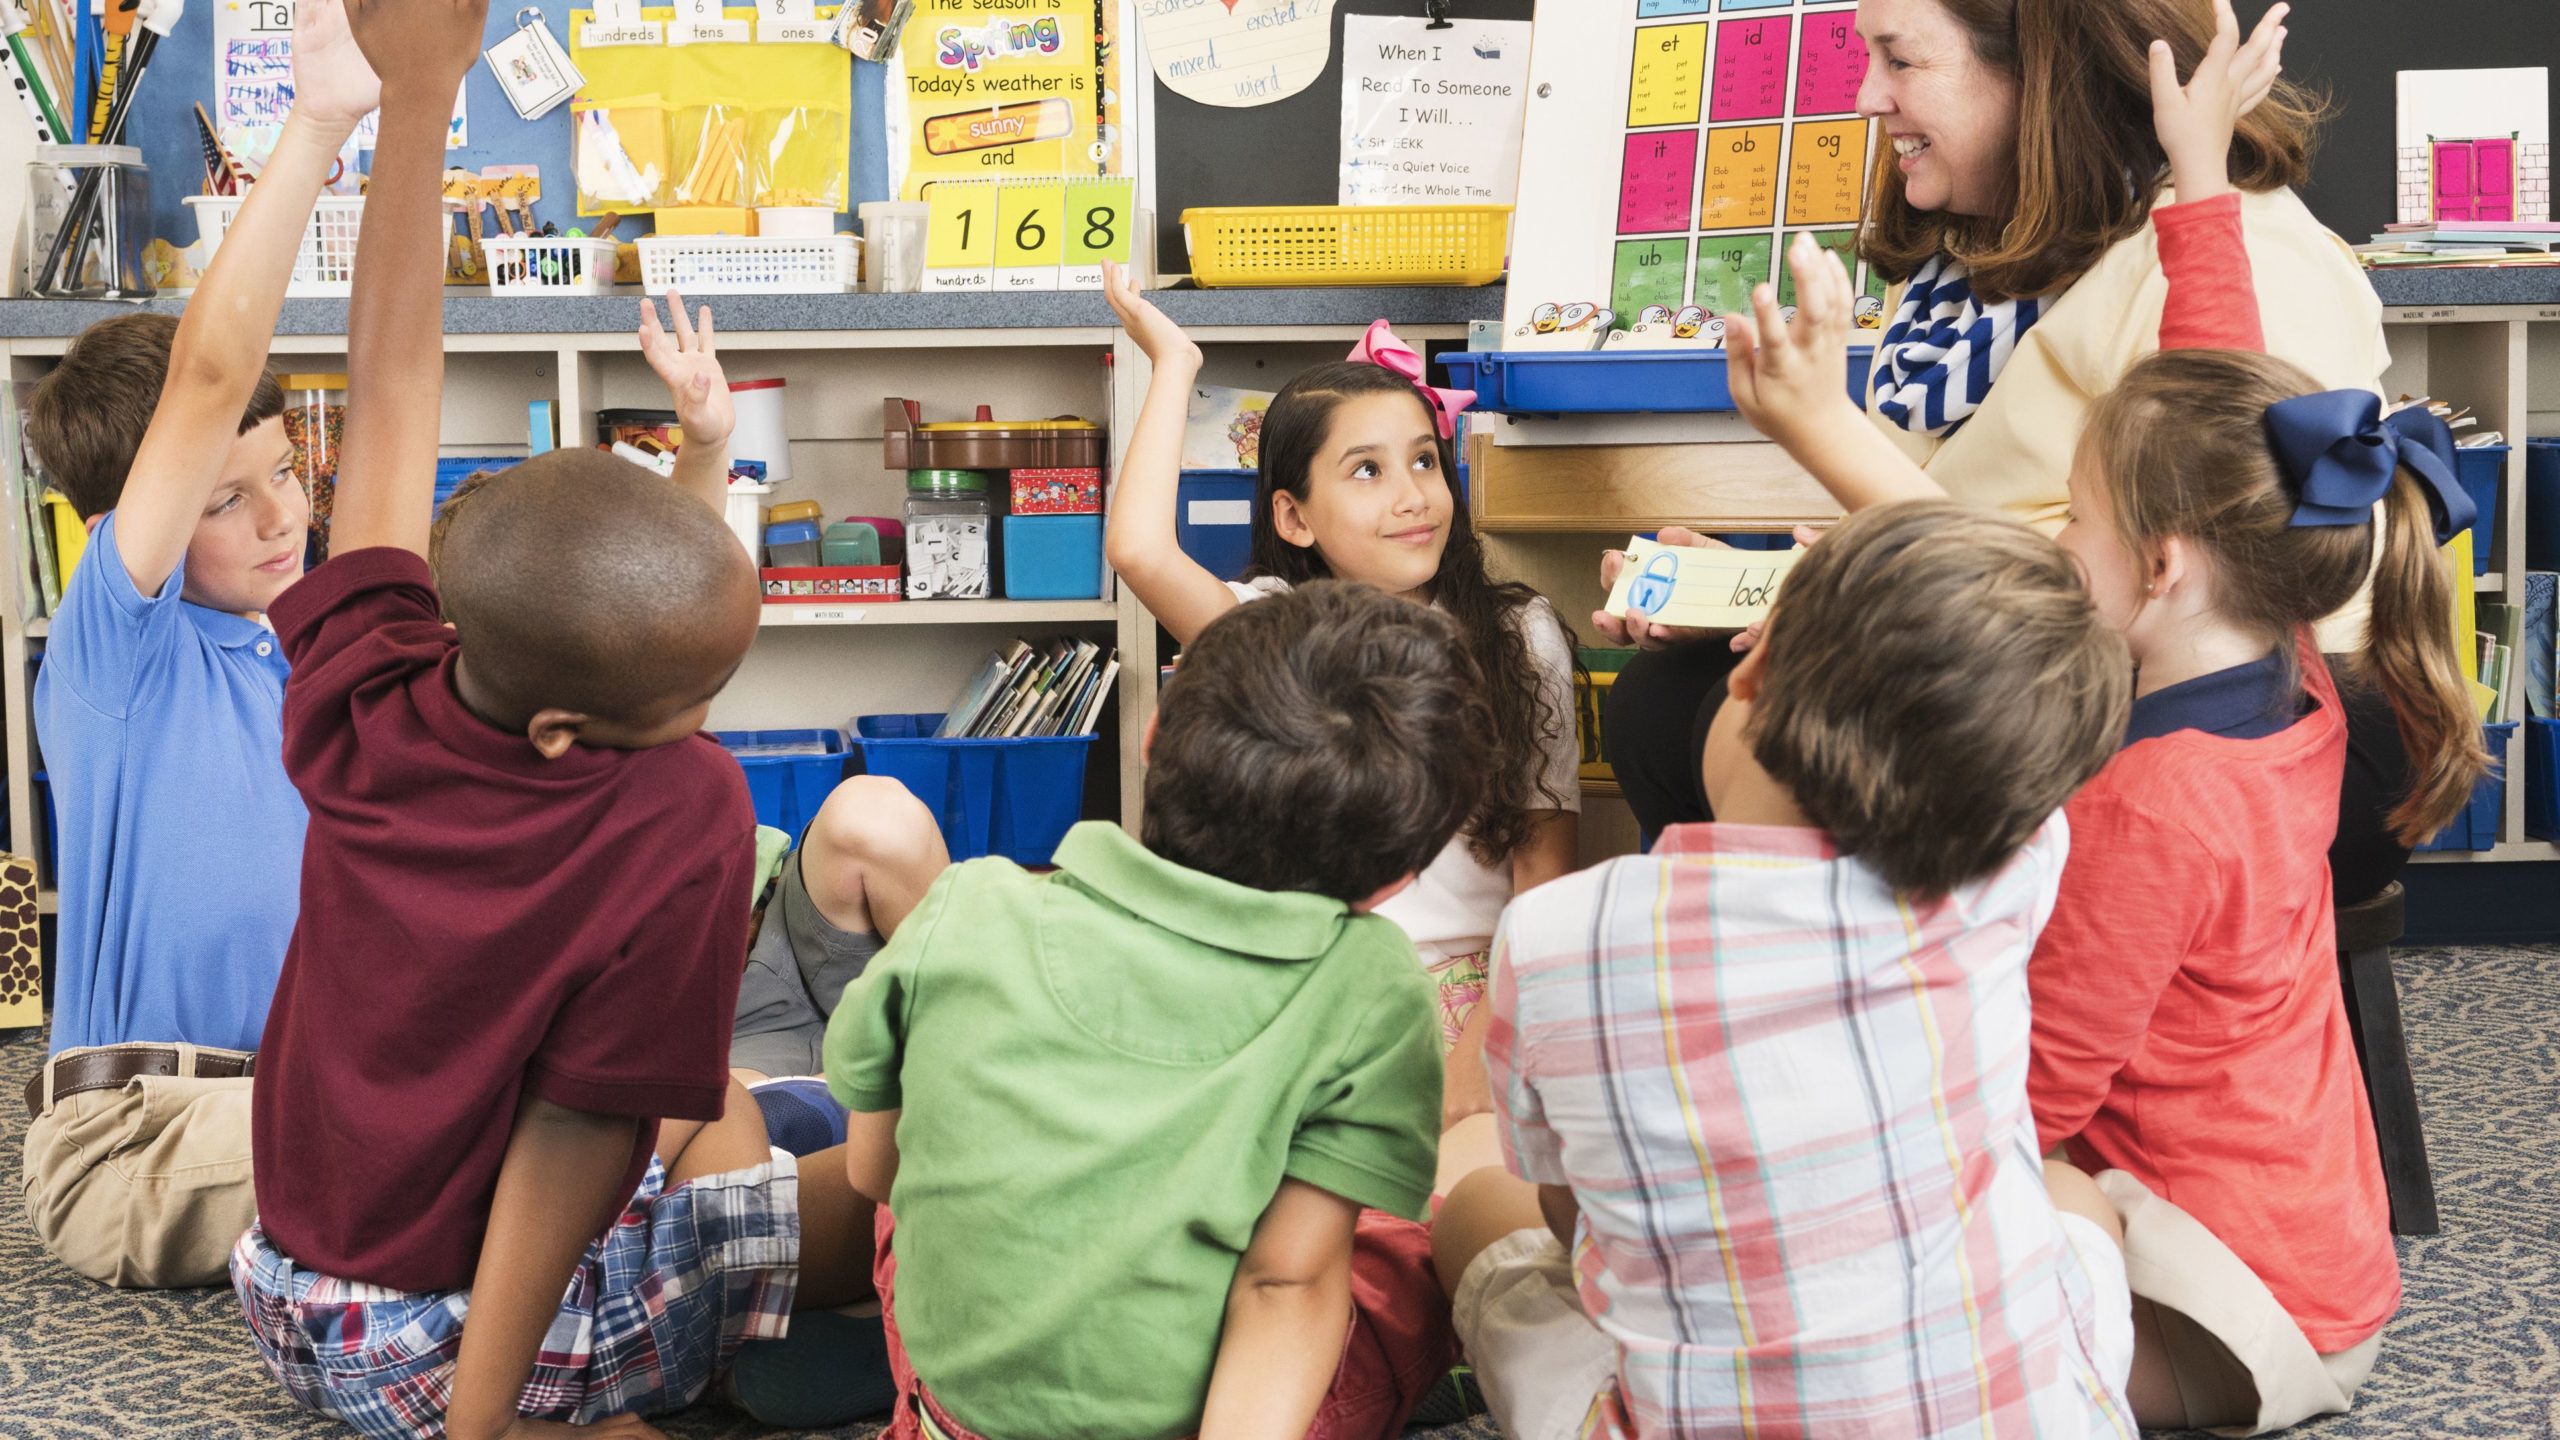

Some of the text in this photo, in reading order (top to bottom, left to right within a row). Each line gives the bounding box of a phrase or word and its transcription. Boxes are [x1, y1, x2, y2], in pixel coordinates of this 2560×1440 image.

[695, 0, 704, 13] 6
[776, 0, 786, 14] 8
[1247, 2, 1302, 31] excited
[588, 27, 815, 43] hundreds tens ones
[1744, 23, 1763, 46] id
[1831, 22, 1847, 49] ig
[940, 17, 1060, 69] Spring
[1661, 34, 1680, 52] et
[1169, 38, 1222, 78] mixed
[1379, 44, 1442, 61] When I
[1763, 52, 1772, 61] lid
[1807, 51, 1818, 62] big
[1847, 49, 1859, 60] pig
[1676, 60, 1688, 71] pet
[1724, 55, 1736, 65] bid
[1639, 63, 1650, 74] jet
[1762, 67, 1773, 76] rid
[1806, 65, 1817, 76] dig
[1846, 63, 1859, 73] wig
[1638, 76, 1647, 85] let
[1723, 70, 1735, 79] did
[907, 73, 1084, 97] Today's weather is
[1362, 76, 1512, 97] Read To Someone
[1721, 85, 1733, 93] hid
[1760, 82, 1775, 94] grid
[1804, 79, 1815, 91] fig
[1636, 91, 1651, 99] met
[1674, 89, 1687, 97] wet
[1635, 105, 1647, 113] net
[1672, 101, 1687, 111] fret
[1399, 107, 1409, 123] I
[969, 114, 1026, 138] sunny
[1368, 137, 1424, 149] Sit EEKK
[1731, 130, 1756, 153] ob
[1817, 134, 1841, 158] og
[1654, 140, 1667, 158] it
[981, 148, 1015, 166] and
[1392, 163, 1399, 172] a
[1402, 161, 1435, 173] Quiet
[1439, 162, 1470, 174] Voice
[1713, 166, 1729, 175] Bob
[1797, 161, 1810, 173] bog
[1838, 159, 1851, 172] jog
[1711, 181, 1725, 190] cob
[1751, 179, 1767, 188] blob
[1795, 176, 1809, 188] dog
[1836, 174, 1847, 186] log
[1402, 184, 1421, 195] the
[1425, 185, 1462, 196] Whole
[1465, 186, 1492, 197] Time
[1794, 191, 1807, 202] fog
[1835, 189, 1851, 200] clog
[1749, 194, 1766, 206] glob
[1709, 211, 1722, 219] rob
[1748, 208, 1767, 218] knob
[1793, 206, 1806, 218] hog
[1834, 204, 1851, 216] frog
[956, 206, 1115, 250] 1 6 8
[1639, 243, 1662, 267] ub
[1721, 249, 1743, 272] ug
[935, 274, 1102, 286] hundreds tens ones
[1729, 568, 1776, 607] lock
